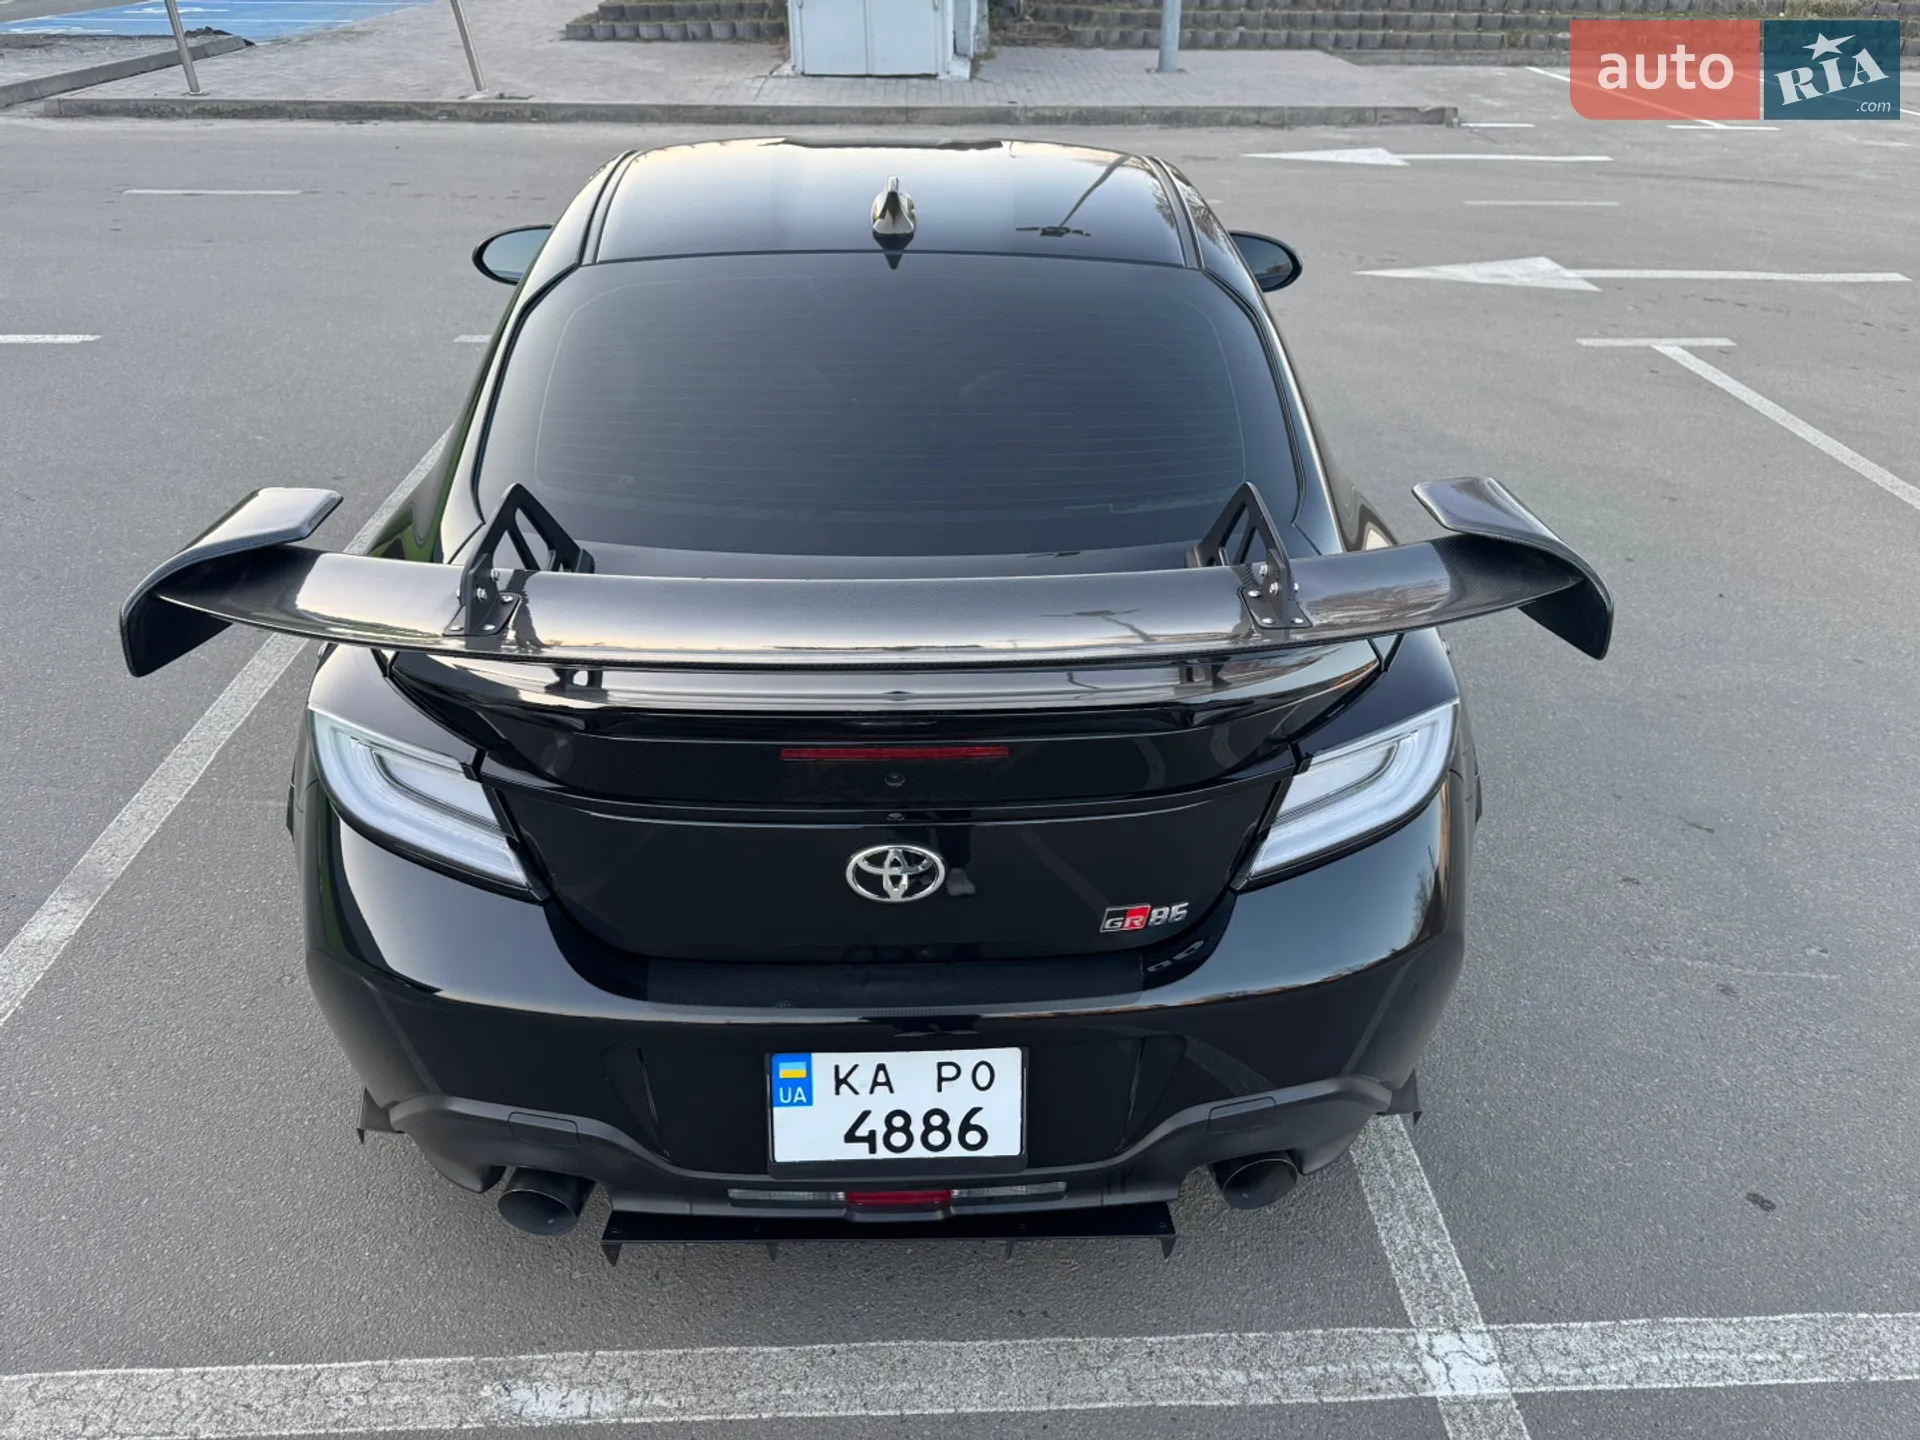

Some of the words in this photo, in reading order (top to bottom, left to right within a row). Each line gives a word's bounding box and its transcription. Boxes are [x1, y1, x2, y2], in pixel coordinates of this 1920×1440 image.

[779, 1086, 807, 1104] UA
[833, 1063, 895, 1096] KA
[843, 1106, 989, 1155] 4886
